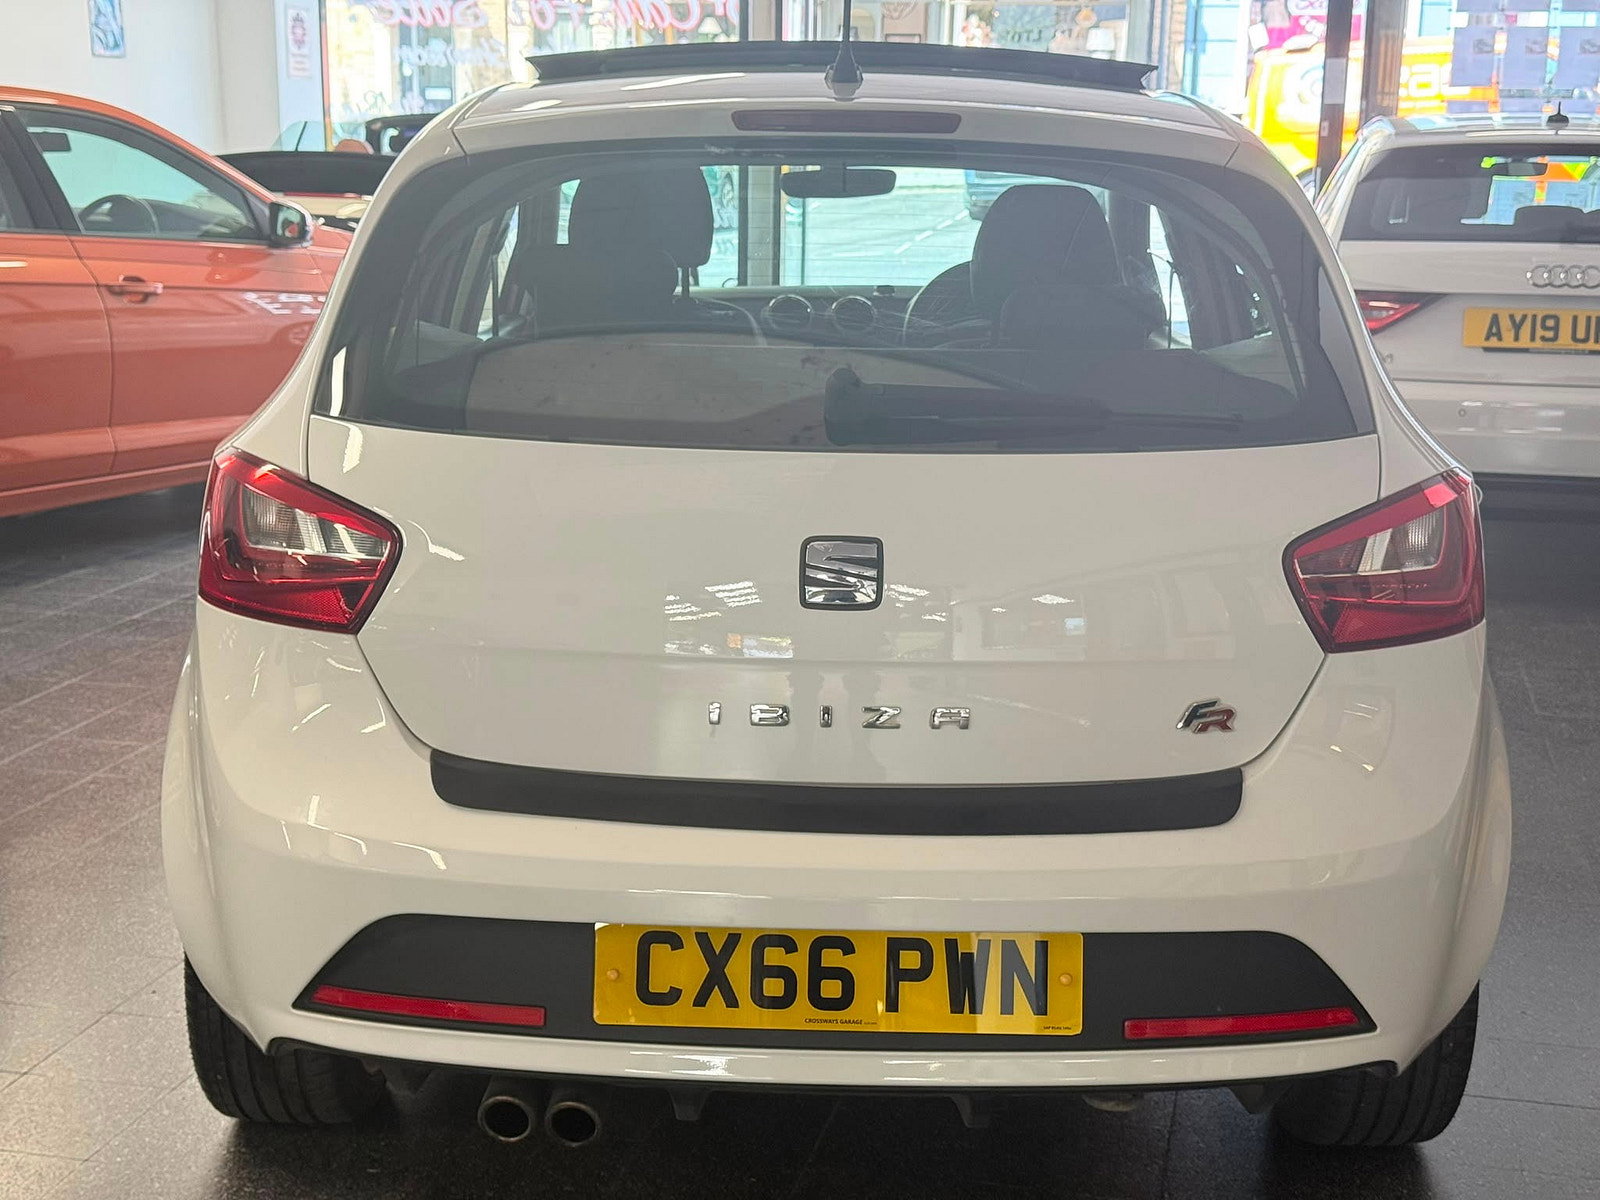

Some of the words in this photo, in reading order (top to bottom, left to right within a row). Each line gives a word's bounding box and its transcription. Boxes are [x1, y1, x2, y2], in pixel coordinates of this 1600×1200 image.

[1484, 313, 1560, 343] AY19
[708, 701, 970, 729] IBIZA
[1176, 699, 1235, 734] FR
[635, 930, 856, 1012] CX66
[885, 936, 1049, 1016] PWN
[804, 1017, 839, 1025] CROSSWAYS
[840, 1018, 863, 1026] GARAGE
